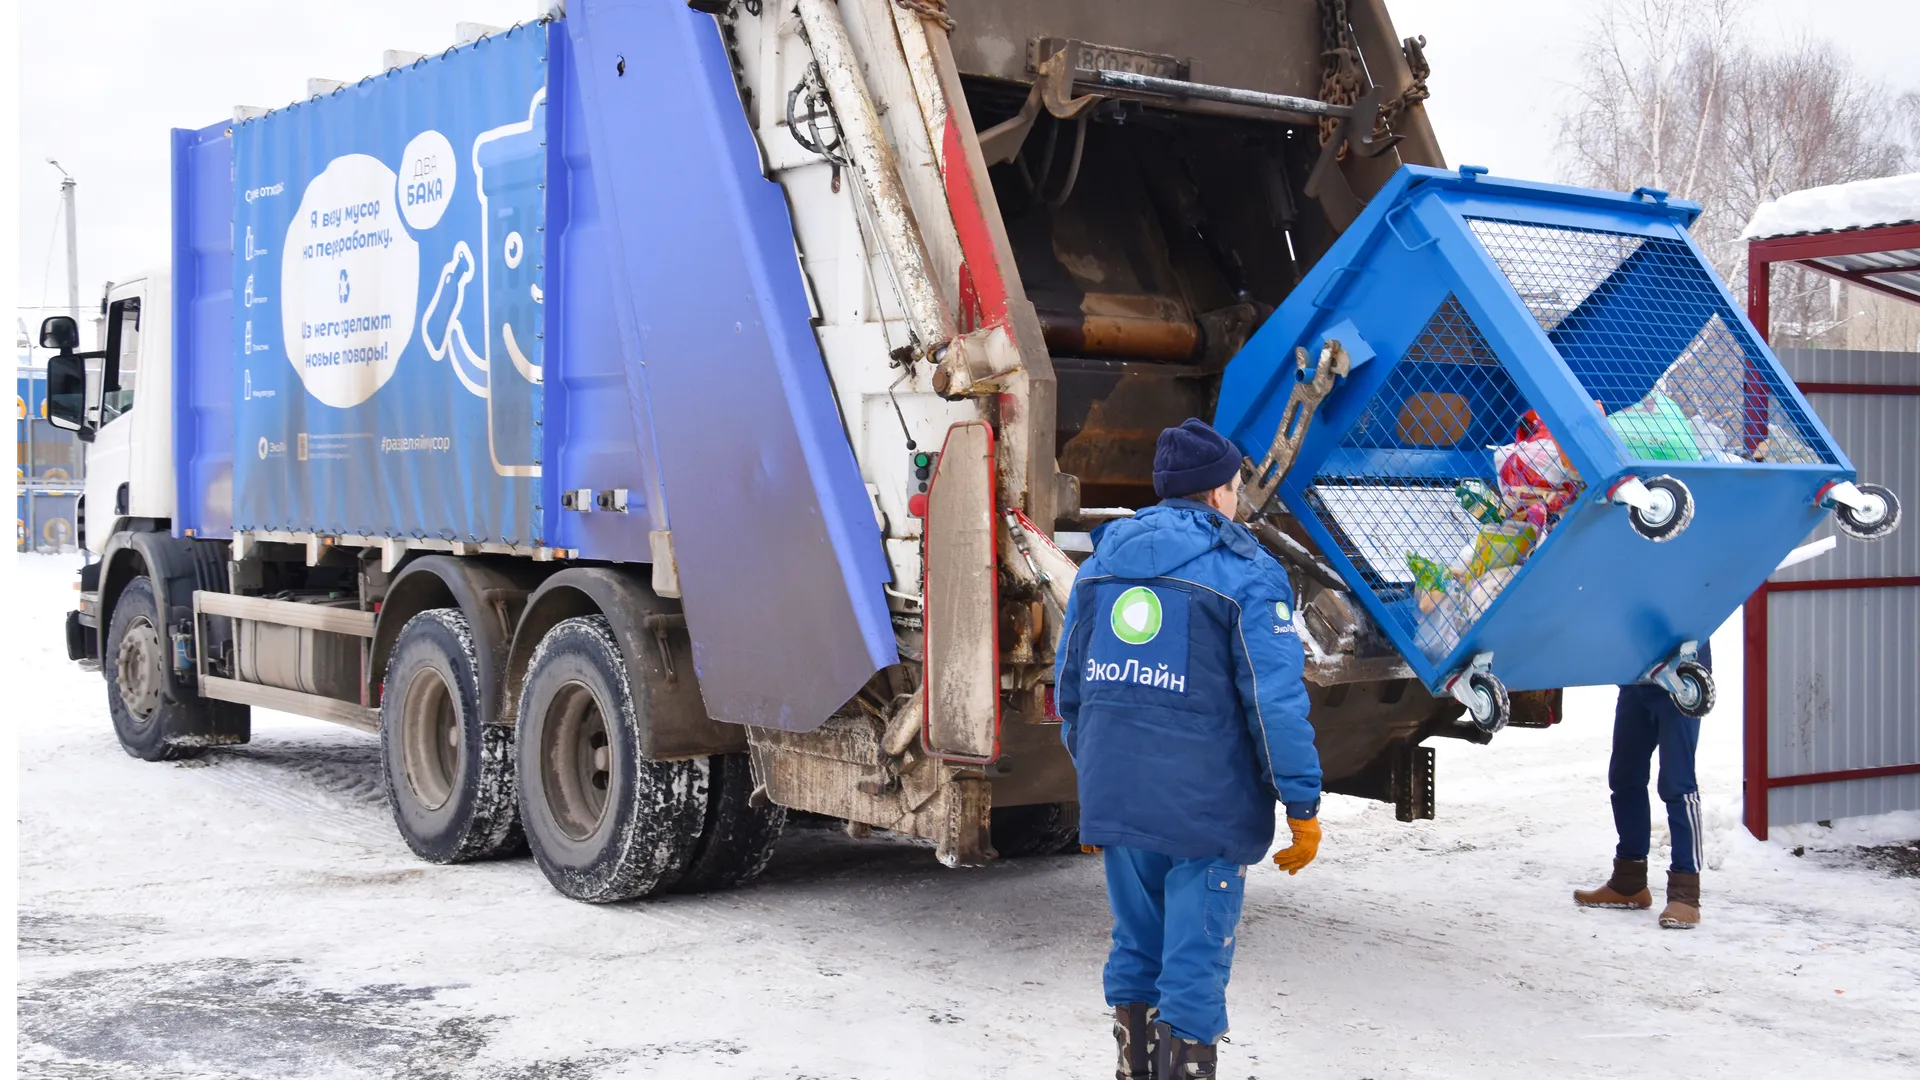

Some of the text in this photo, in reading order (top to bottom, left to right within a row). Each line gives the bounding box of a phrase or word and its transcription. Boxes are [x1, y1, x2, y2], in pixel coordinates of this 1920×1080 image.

[413, 154, 437, 180] ДВА
[407, 177, 443, 207] БАКА
[310, 210, 318, 229] Я
[345, 199, 380, 225] мусор
[303, 244, 314, 261] на
[314, 321, 340, 338] него
[1085, 658, 1185, 693] ЭкоЛайн
